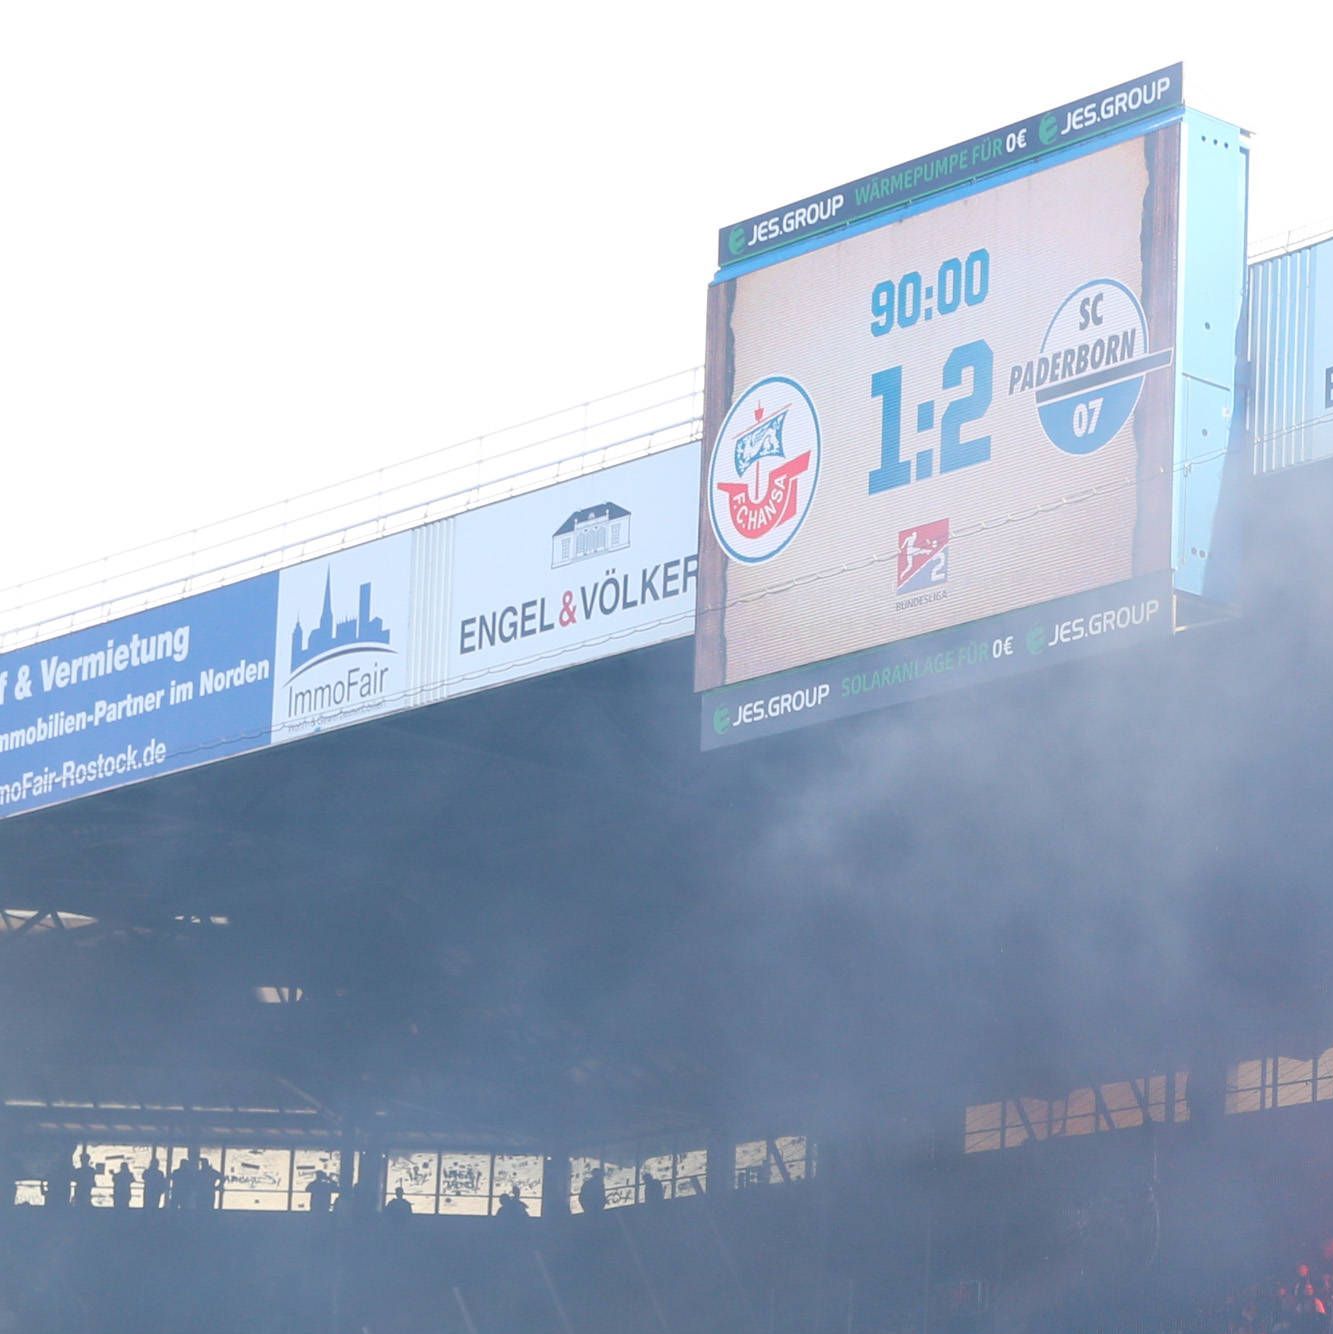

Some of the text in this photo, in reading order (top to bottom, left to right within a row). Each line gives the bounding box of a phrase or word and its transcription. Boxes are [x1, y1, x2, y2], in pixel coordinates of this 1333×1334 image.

[1061, 76, 1170, 135] JES.GROUP
[747, 127, 1027, 247] JES.GROUP WÄRMEPUMPE FÜR 0€
[870, 247, 990, 337] 90:00
[1079, 293, 1104, 331] SC
[1008, 328, 1137, 396] PADERBORN
[868, 338, 994, 496] 1:2
[1072, 397, 1104, 438] 07
[931, 552, 946, 582] 2
[895, 590, 948, 612] BUNDESLIGA
[14, 664, 33, 700] &
[41, 625, 190, 692] Vermietung
[170, 680, 194, 705] im
[200, 659, 270, 697] Norden
[287, 663, 389, 718] ImmoFair
[732, 600, 1159, 727] JES.GROUP SOLARANLAGE FÜR 0€ JES.GROUP
